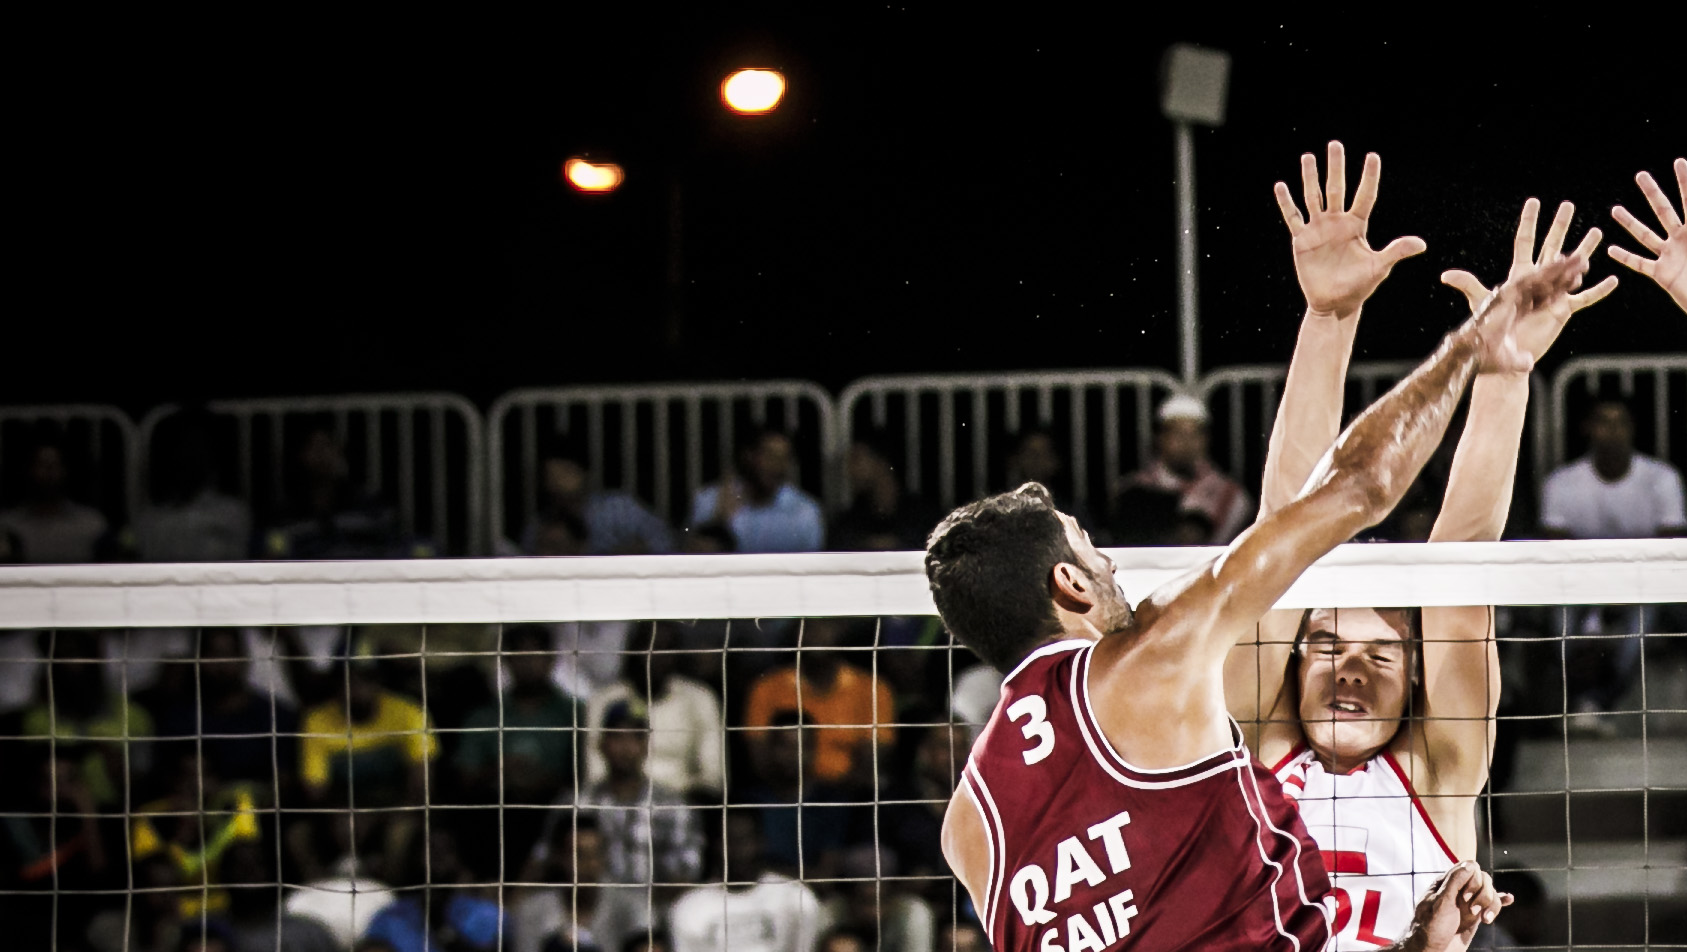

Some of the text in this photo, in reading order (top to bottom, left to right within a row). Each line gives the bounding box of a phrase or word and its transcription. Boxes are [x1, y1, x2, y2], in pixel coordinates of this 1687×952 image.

[1006, 694, 1056, 766] 3
[1009, 811, 1132, 926] QAT
[1322, 887, 1395, 948] OL
